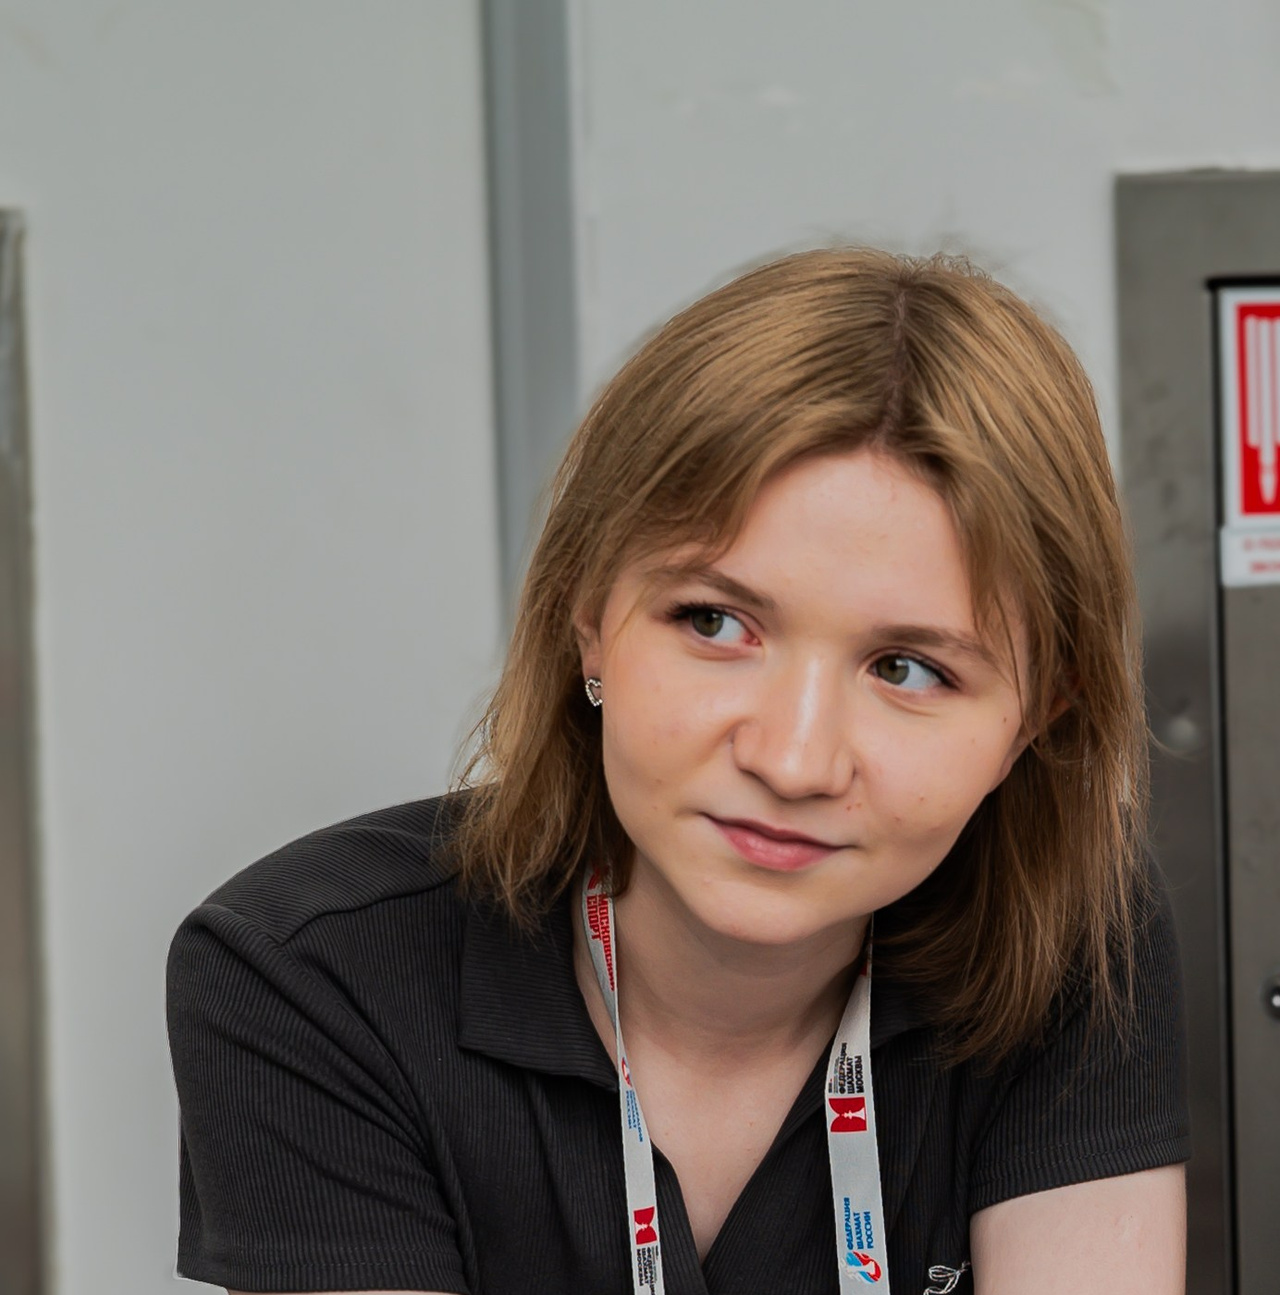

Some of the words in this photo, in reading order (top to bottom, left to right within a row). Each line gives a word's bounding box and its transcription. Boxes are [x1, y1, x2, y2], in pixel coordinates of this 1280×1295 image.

[586, 895, 601, 941] СПОРТ
[838, 1042, 848, 1095] ФЕДЕРАЦИЯ
[846, 1056, 855, 1094] ШАХМАТ
[854, 1055, 864, 1094] МОСКВЫ
[844, 1197, 854, 1250] ФЕДЕРАЦИЯ
[853, 1211, 864, 1250] ШАХМАТ
[863, 1211, 874, 1249] РОССИИ
